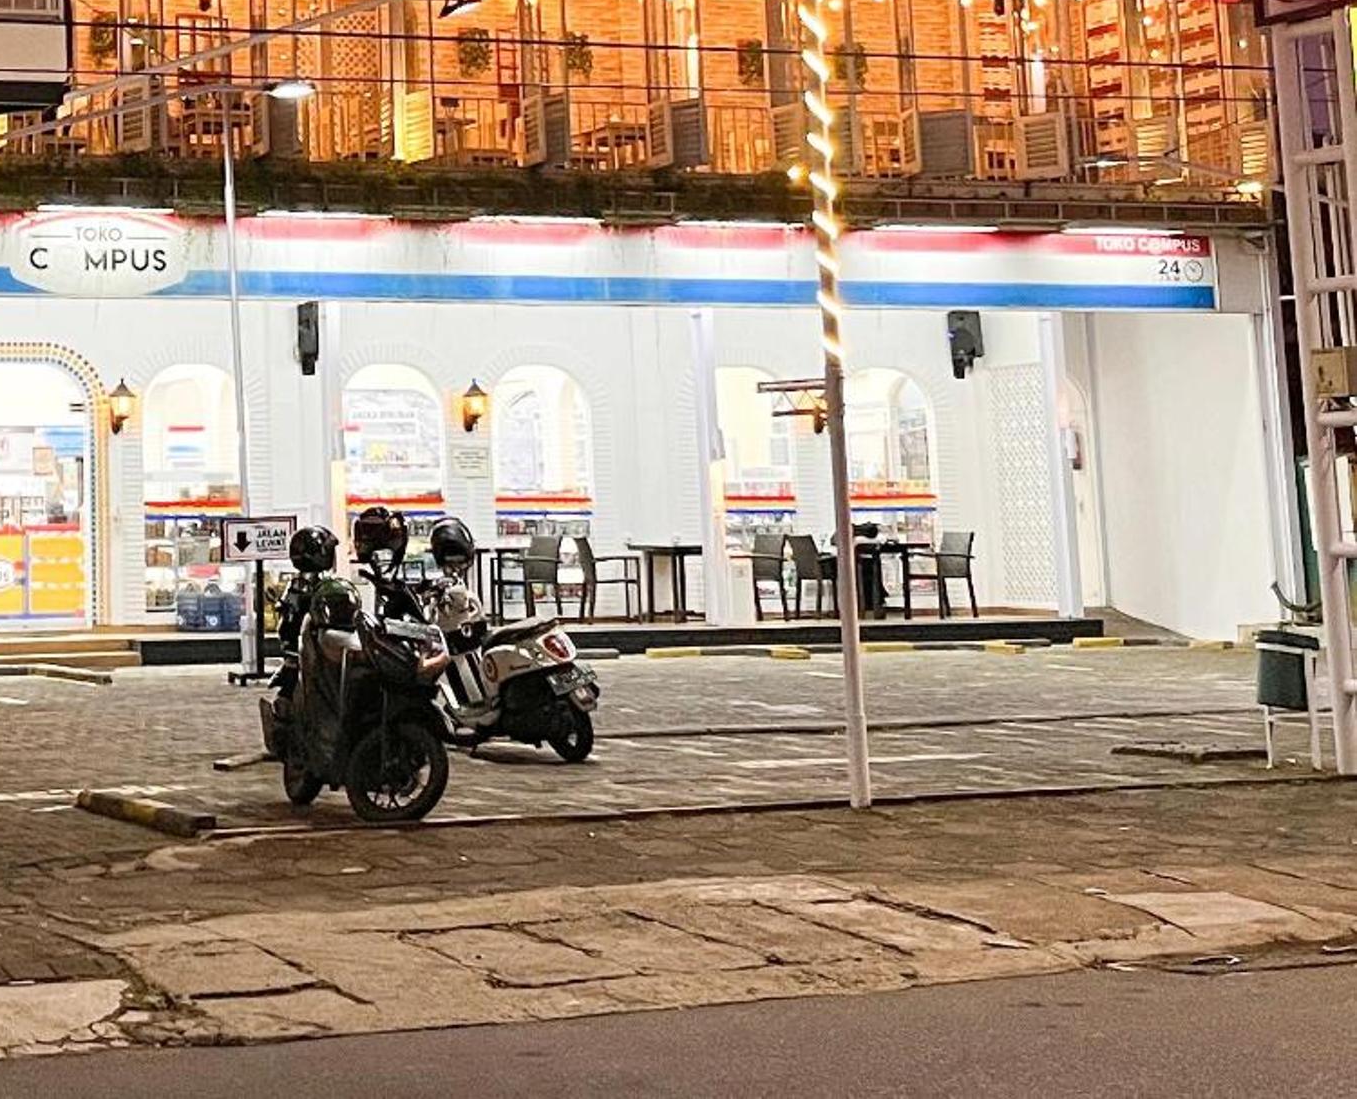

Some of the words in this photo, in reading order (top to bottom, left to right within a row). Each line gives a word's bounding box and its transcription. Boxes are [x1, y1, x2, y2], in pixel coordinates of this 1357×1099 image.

[74, 226, 123, 242] TOKO
[1095, 236, 1135, 251] TOKO
[29, 247, 167, 271] CMPUS
[1158, 259, 1180, 274] 24
